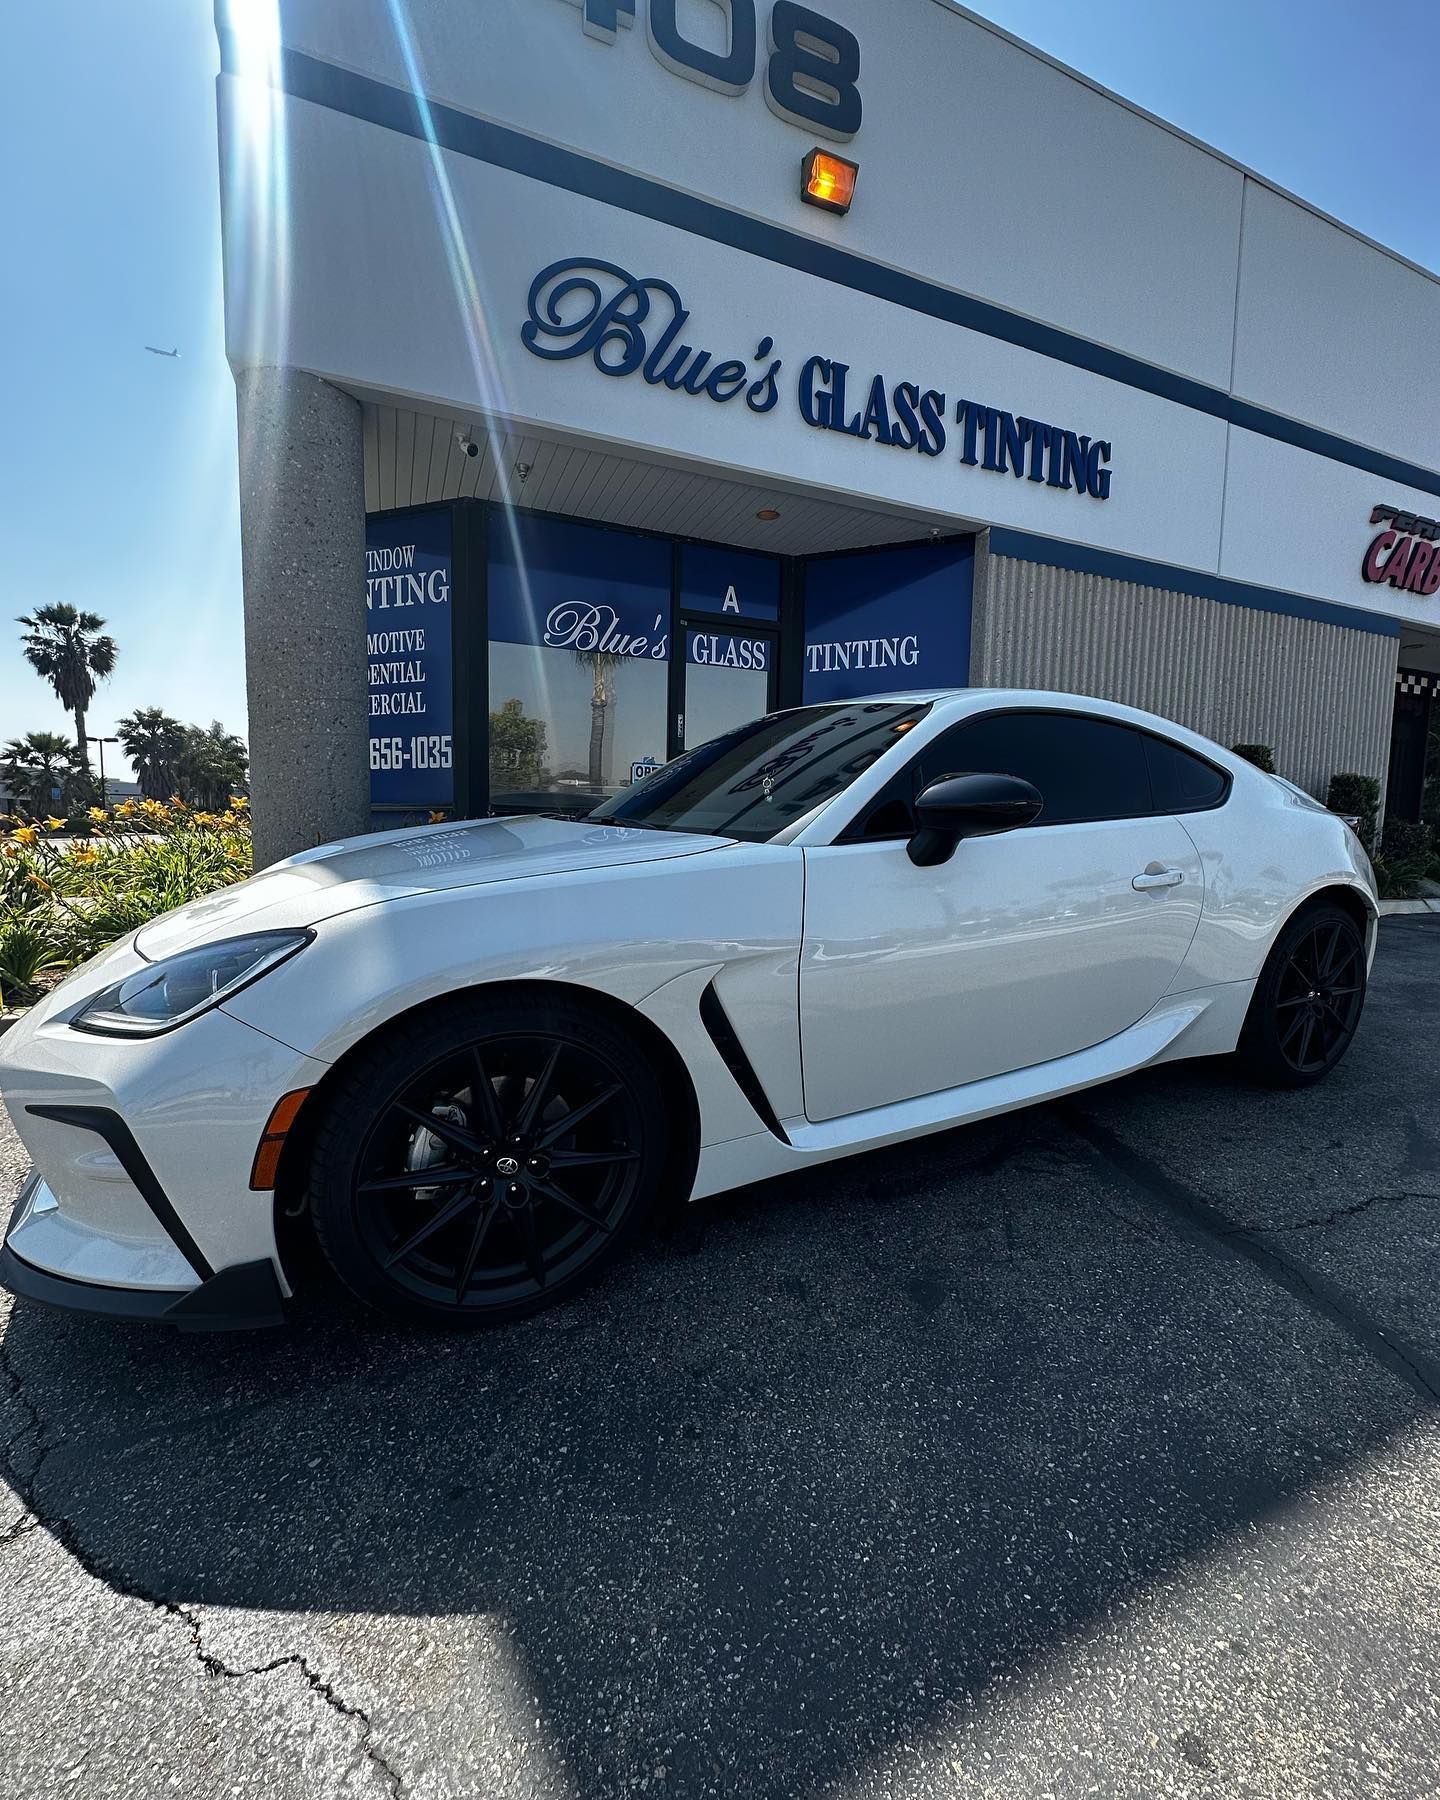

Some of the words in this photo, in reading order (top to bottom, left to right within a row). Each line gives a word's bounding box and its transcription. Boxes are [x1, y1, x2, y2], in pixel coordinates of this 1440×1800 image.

[521, 256, 782, 413] Blue's
[798, 355, 946, 456] GLASS
[956, 398, 1113, 500] TINTING
[366, 544, 415, 573] INDOW
[1361, 530, 1440, 596] CARB
[722, 585, 740, 613] A
[543, 600, 668, 659] Blue's
[692, 633, 765, 670] GLASS
[806, 635, 920, 673] TINTING
[367, 660, 426, 685] ENTIAL
[368, 691, 426, 716] ERCIAL
[369, 735, 453, 770] 656-1035
